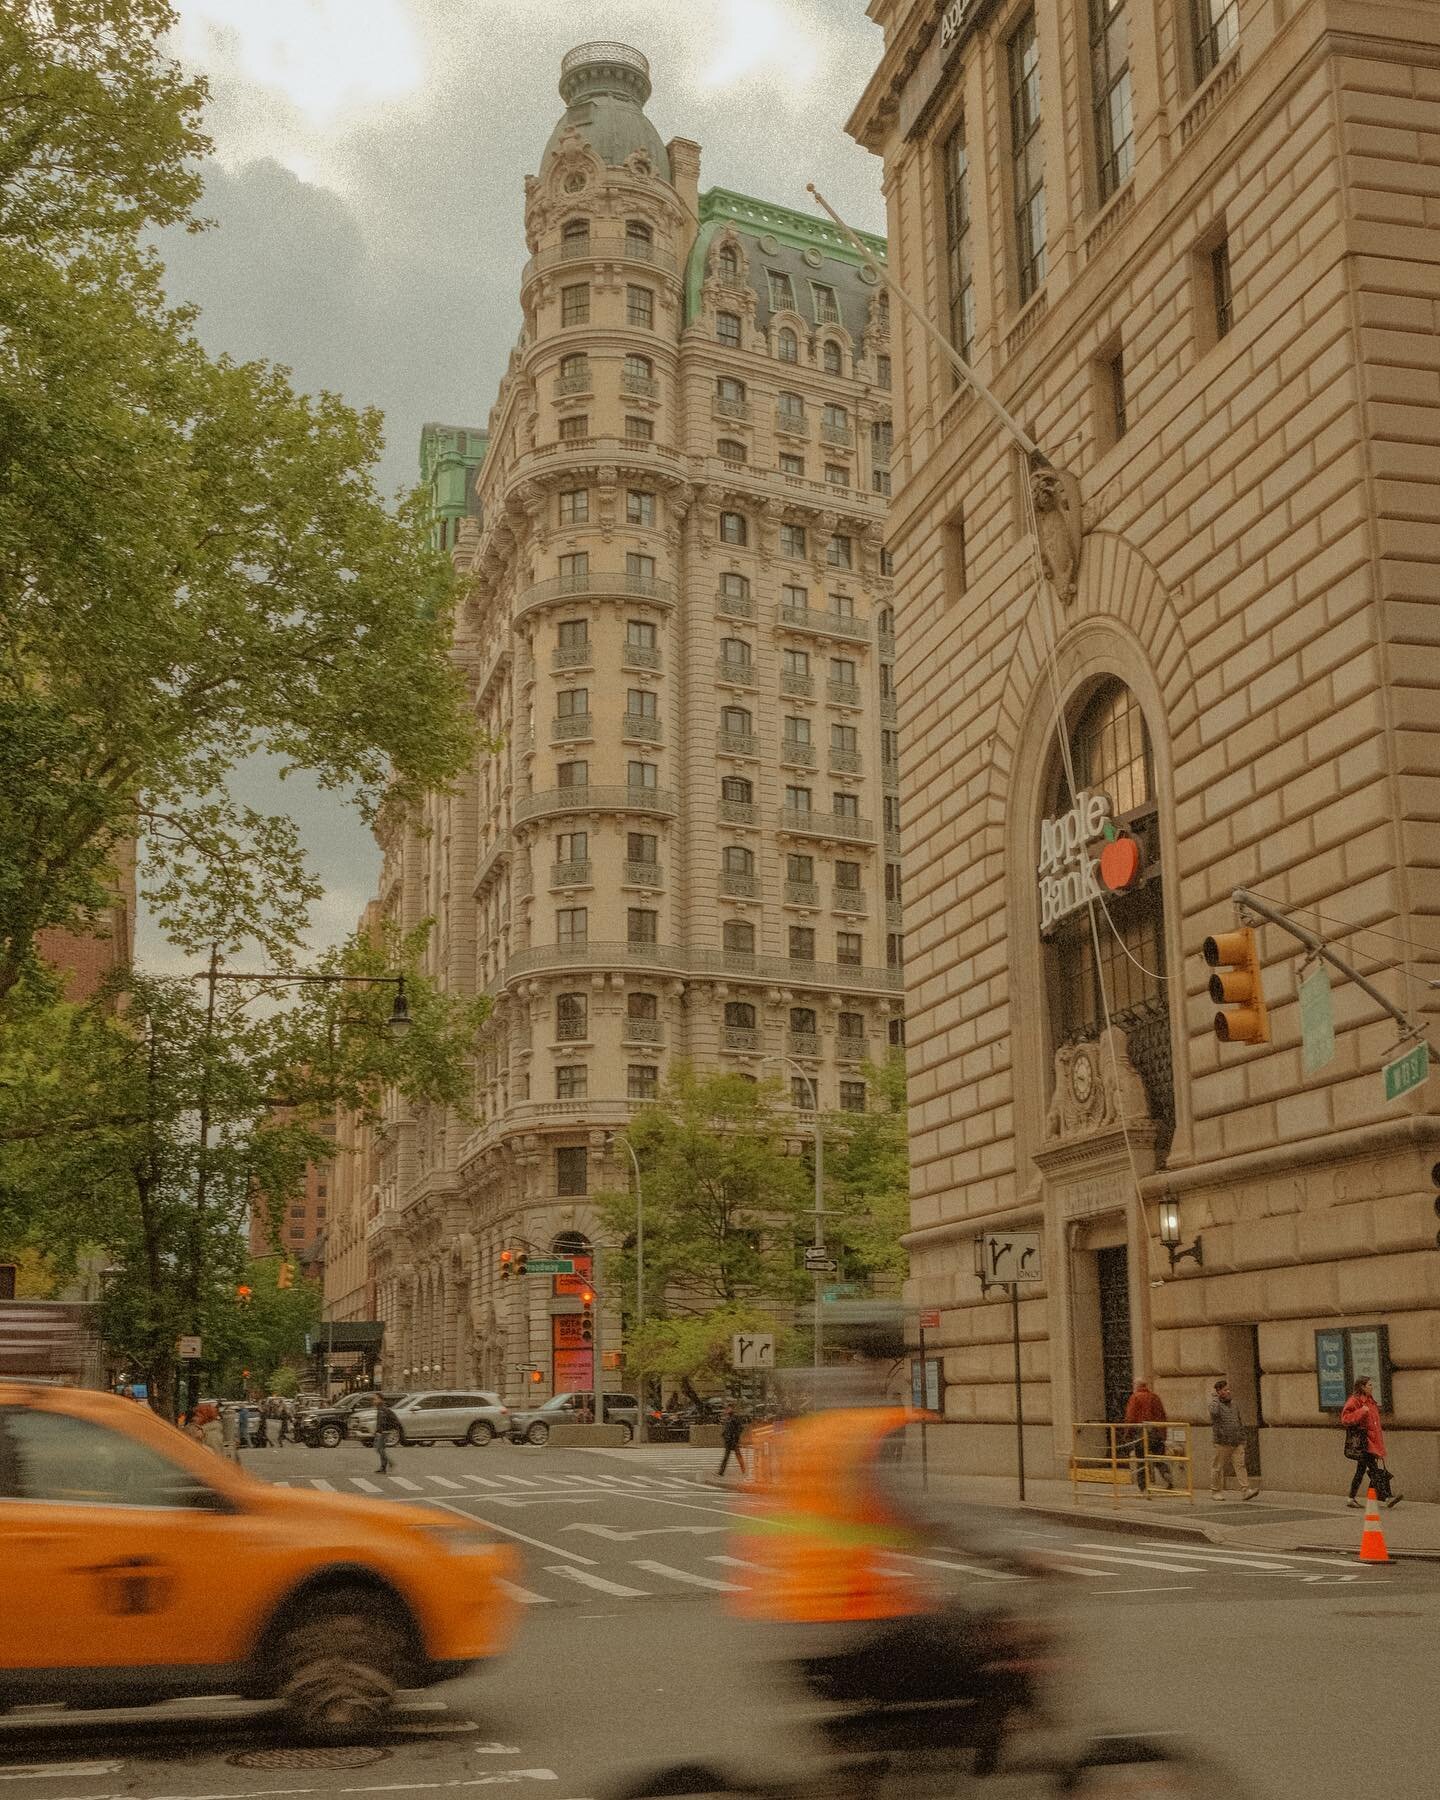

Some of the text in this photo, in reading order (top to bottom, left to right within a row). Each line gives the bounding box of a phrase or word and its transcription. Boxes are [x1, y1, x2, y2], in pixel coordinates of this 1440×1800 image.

[1038, 791, 1110, 874] Apple
[1038, 853, 1105, 930] Bank
[526, 1263, 559, 1273] roadway
[1019, 1270, 1041, 1279] ONLY
